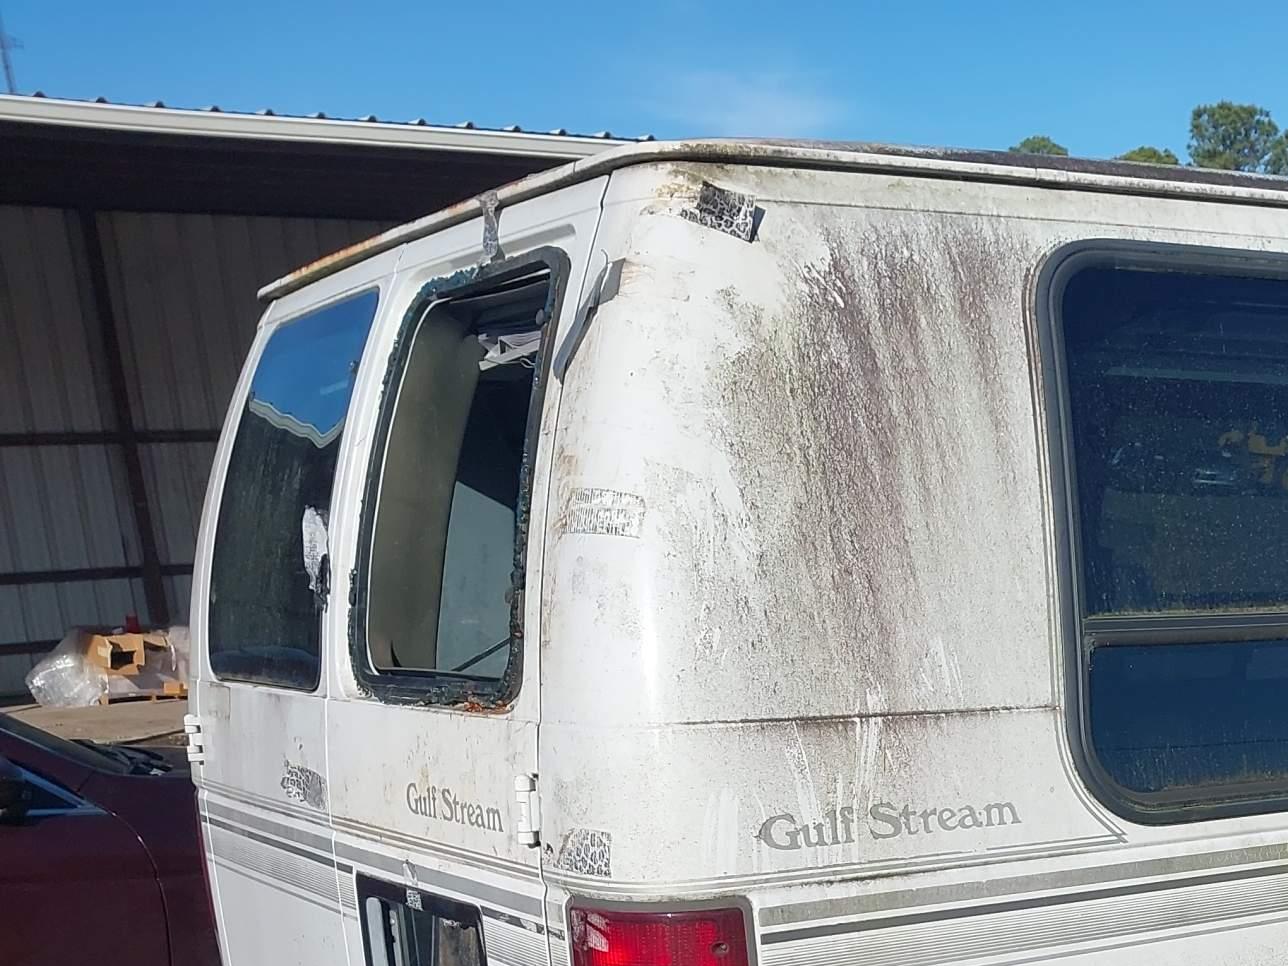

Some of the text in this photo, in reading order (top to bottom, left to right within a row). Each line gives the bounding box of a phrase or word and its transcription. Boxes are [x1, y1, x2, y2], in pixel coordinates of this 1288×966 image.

[406, 782, 504, 833] Gulf Stream
[757, 800, 1022, 850] Gulf Stream
